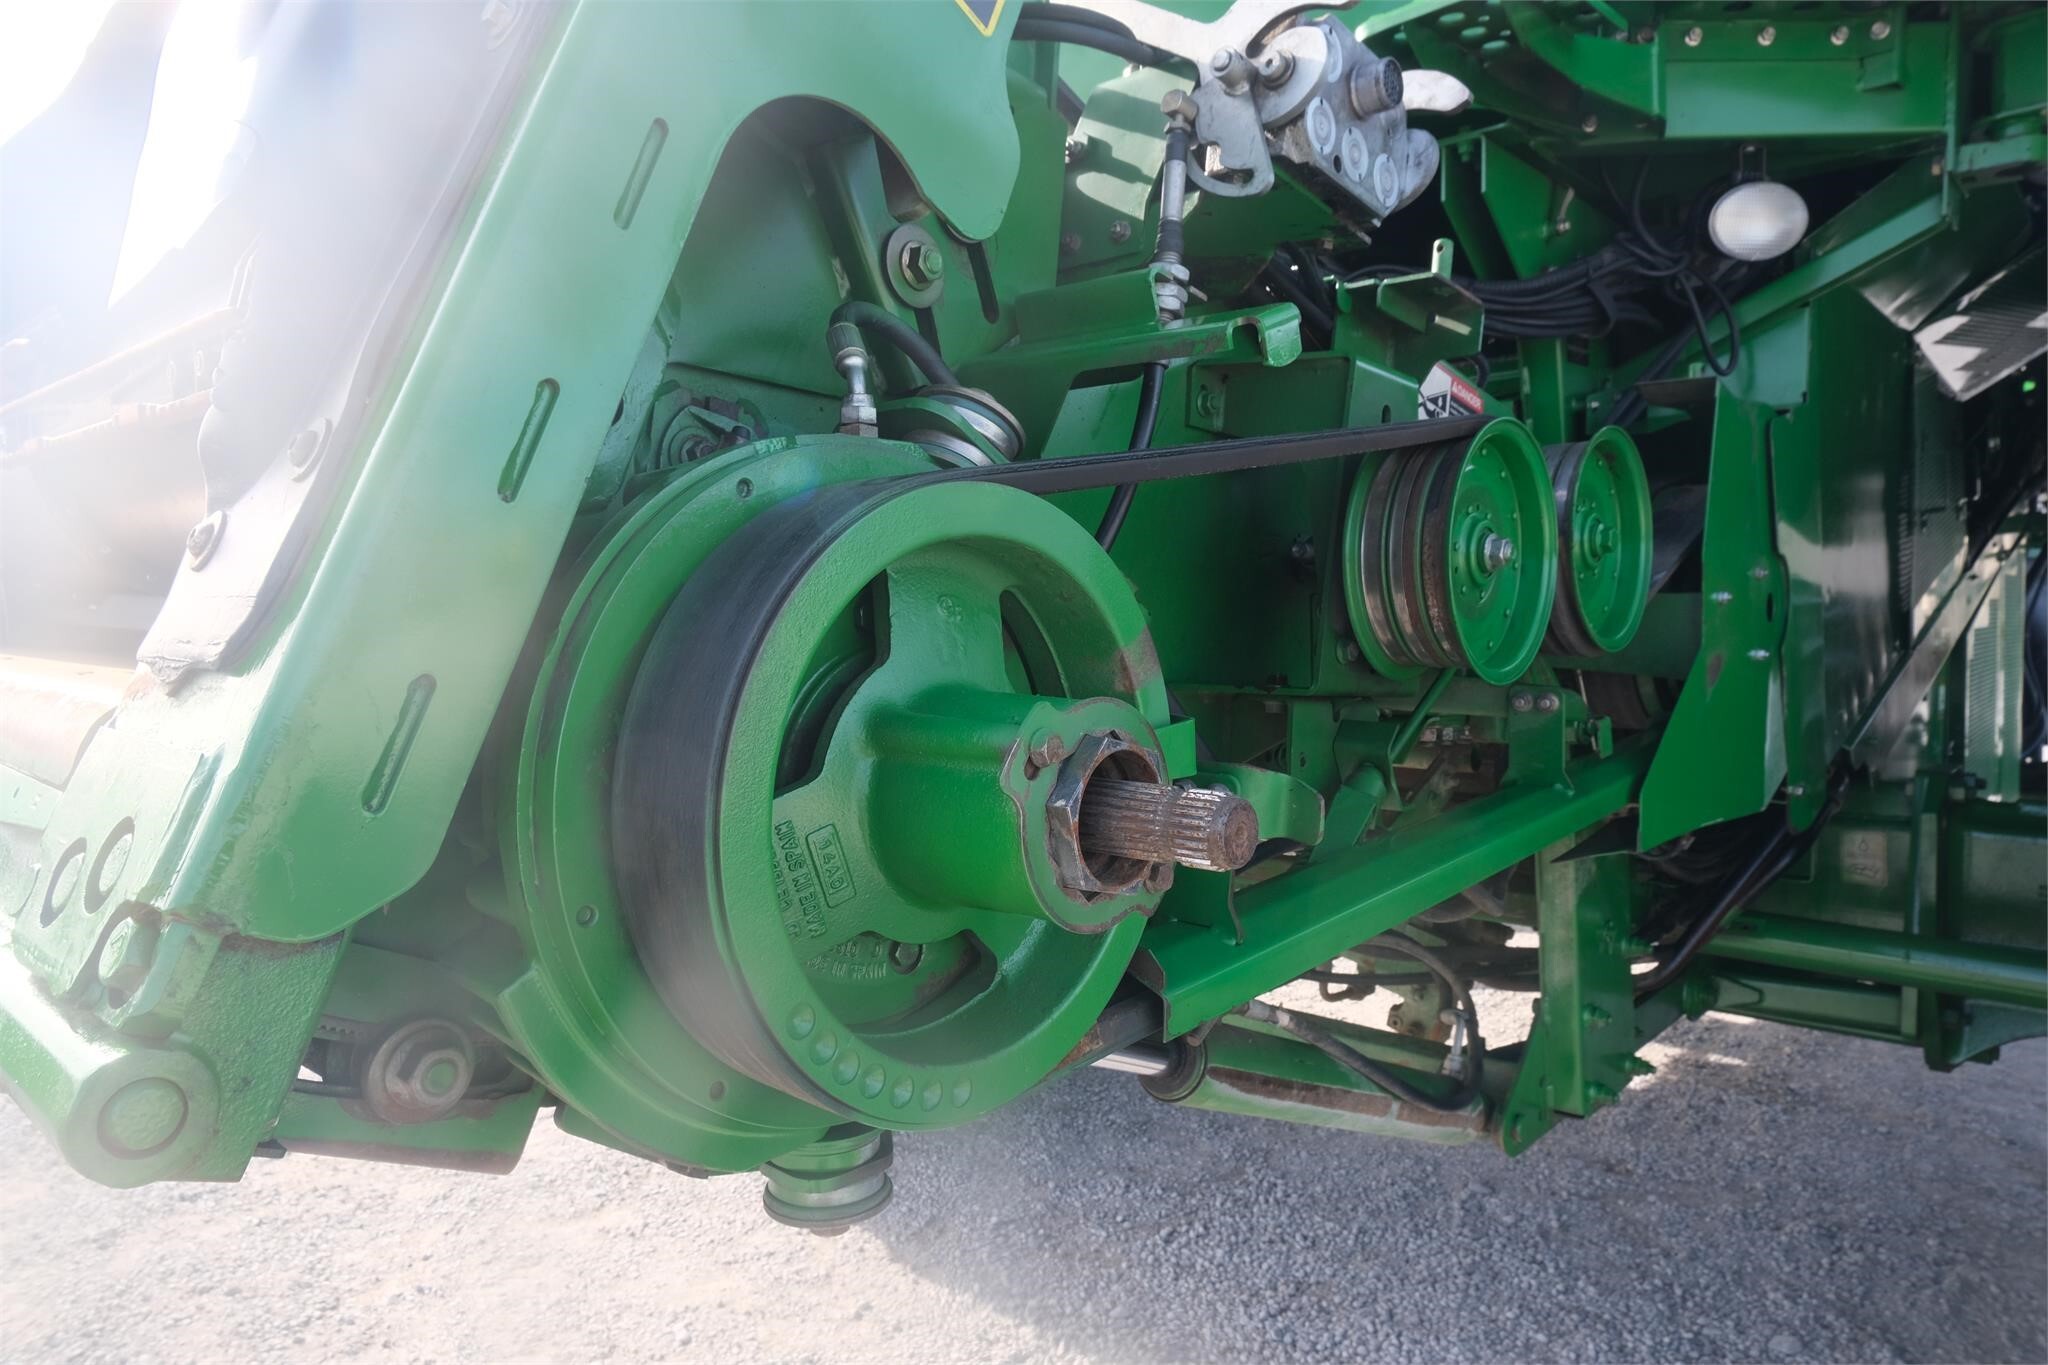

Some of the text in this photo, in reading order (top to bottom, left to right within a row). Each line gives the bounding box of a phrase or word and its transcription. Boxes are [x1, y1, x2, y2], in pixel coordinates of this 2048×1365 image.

[774, 819, 806, 872] SPAIN
[792, 872, 815, 893] IN
[799, 891, 828, 939] MADE
